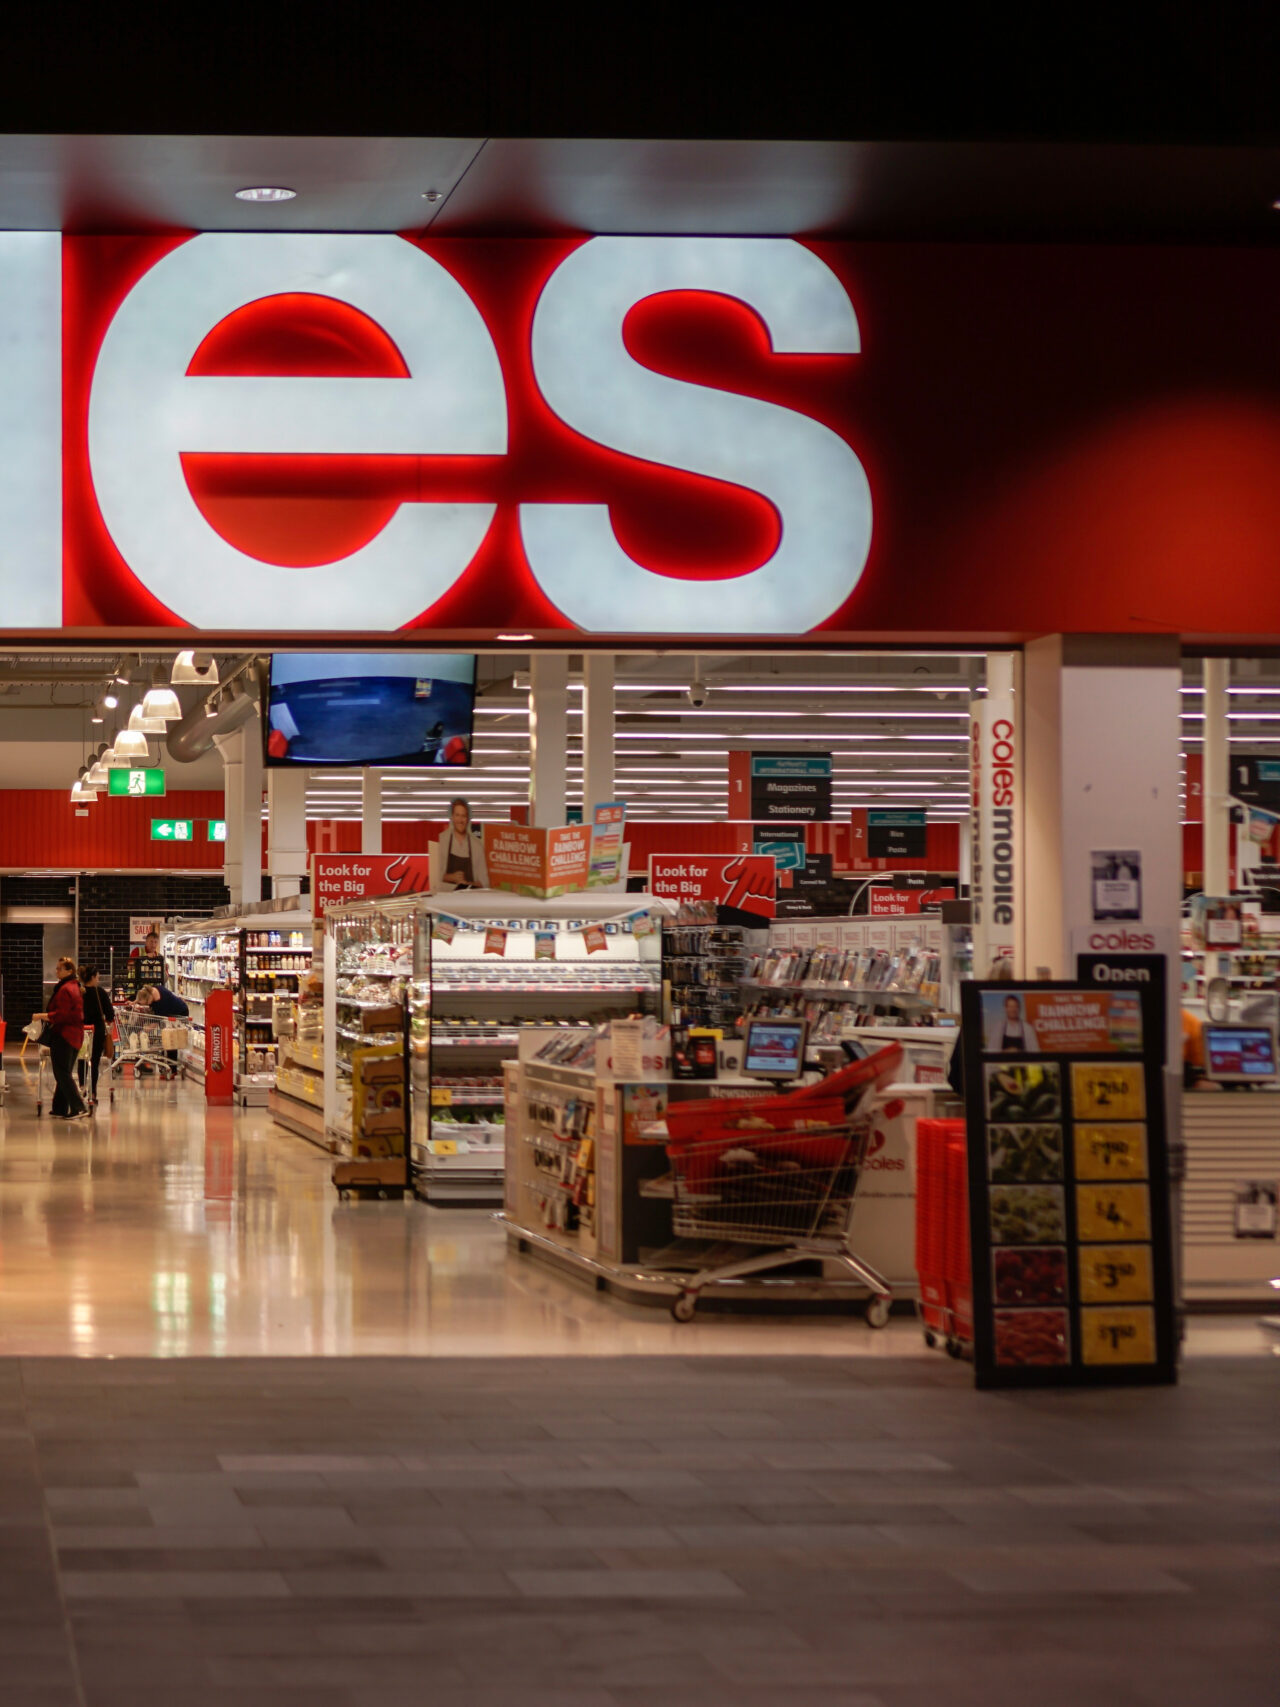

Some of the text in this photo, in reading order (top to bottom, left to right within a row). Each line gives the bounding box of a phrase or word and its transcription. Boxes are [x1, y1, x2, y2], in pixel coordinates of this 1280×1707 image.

[1237, 765, 1249, 785] 1
[736, 780, 742, 792] 1
[767, 783, 817, 794] Magazines
[1190, 783, 1201, 795] 2
[768, 804, 816, 816] Stationery
[500, 832, 517, 840] TAKE
[855, 828, 863, 838] 2
[492, 839, 537, 854] RAINBOW
[553, 840, 586, 853] RAINBOW
[742, 843, 749, 851] 2
[489, 851, 542, 867] CHALLENGE
[550, 851, 587, 866] CHALLENGE
[319, 864, 372, 876] Look for
[655, 865, 709, 877] Look for
[318, 880, 365, 895] the Big
[655, 881, 702, 896] the Big
[319, 897, 344, 907] Red
[873, 894, 910, 902] Look for
[873, 905, 905, 914] the Big
[1089, 929, 1155, 950] coles
[1092, 963, 1150, 981] Open
[1037, 1003, 1101, 1017] RAINBOW
[1035, 1017, 1108, 1032] CHALLENGE
[863, 1157, 905, 1171] coles
